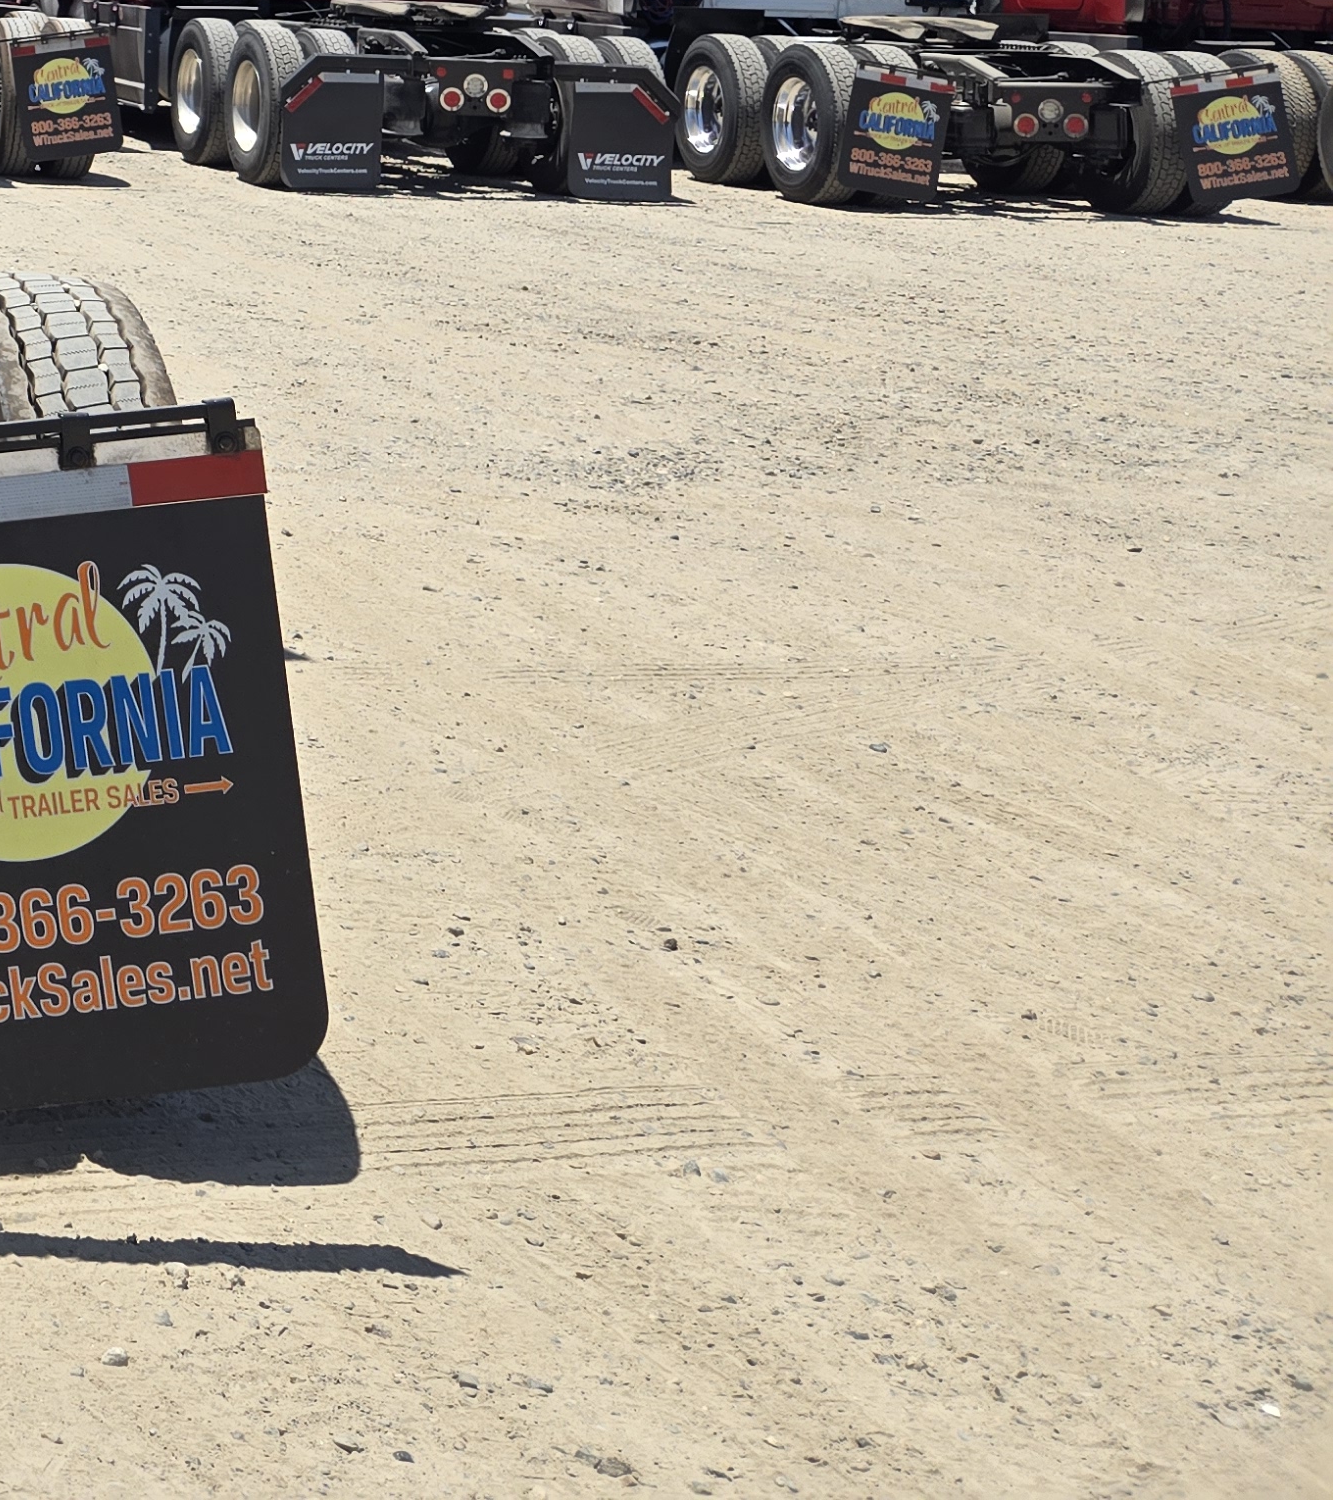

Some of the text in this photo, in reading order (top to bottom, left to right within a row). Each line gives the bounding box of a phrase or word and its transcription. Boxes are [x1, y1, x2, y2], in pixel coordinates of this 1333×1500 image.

[28, 76, 106, 102] CALIFORNIA
[859, 110, 935, 140] CALIFORNIA
[1192, 112, 1278, 144] CALIFORNIA
[306, 143, 374, 154] VELOCITY
[594, 153, 665, 166] VELOCITY
[9, 789, 101, 822] TRAILER
[107, 778, 180, 809] SALES
